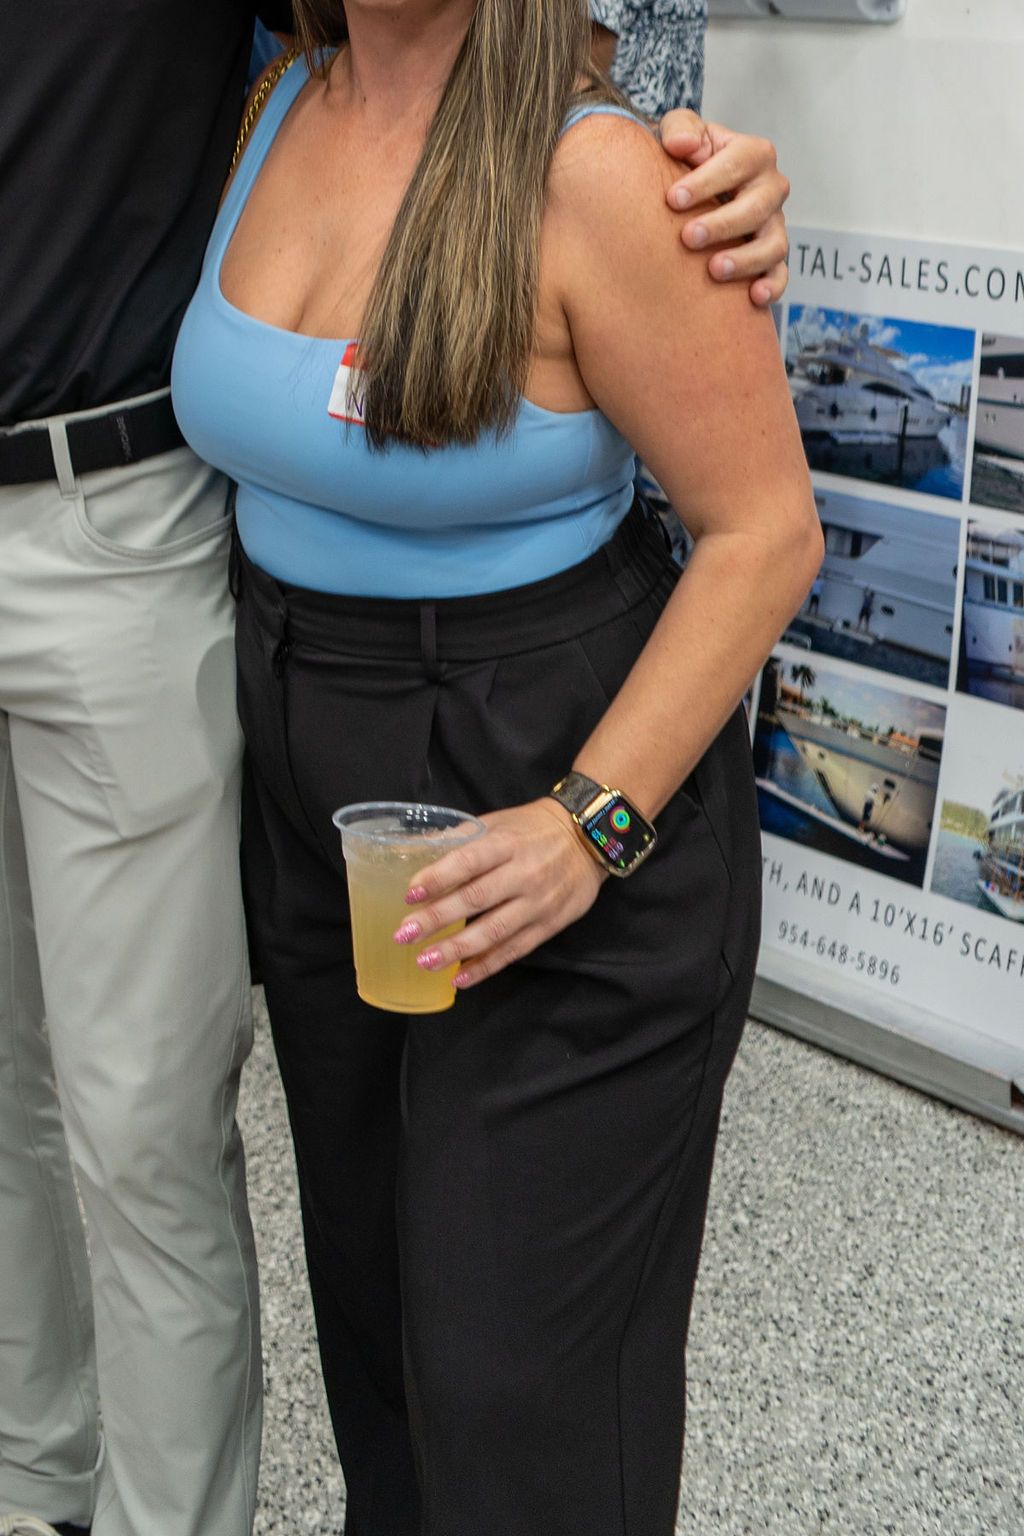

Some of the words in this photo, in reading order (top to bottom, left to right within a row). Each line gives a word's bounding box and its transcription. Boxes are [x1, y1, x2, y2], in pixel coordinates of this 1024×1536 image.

[786, 243, 1024, 302] TAL-SALES.CO
[762, 856, 788, 892] H,
[796, 871, 842, 905] AND
[848, 891, 861, 915] A
[959, 932, 1024, 977] SCAF
[778, 921, 900, 984] 954-648-5896
